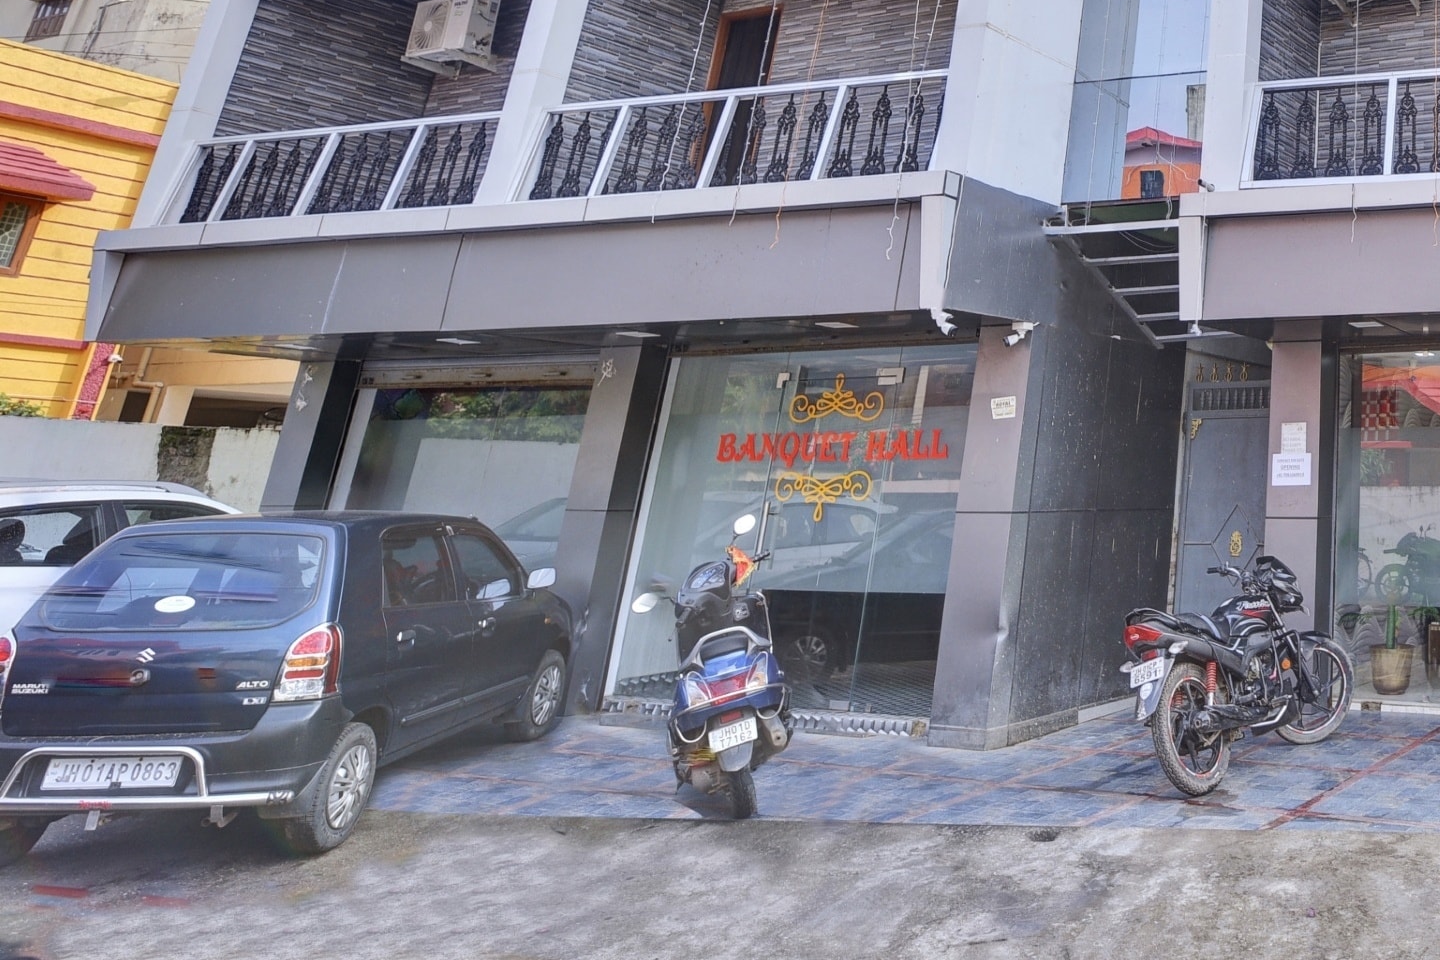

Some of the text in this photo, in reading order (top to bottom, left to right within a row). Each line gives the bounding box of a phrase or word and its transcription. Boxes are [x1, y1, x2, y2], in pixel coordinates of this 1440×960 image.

[716, 428, 948, 468] BANQUET HALL
[1134, 668, 1158, 684] 6591
[236, 680, 269, 689] ALTO
